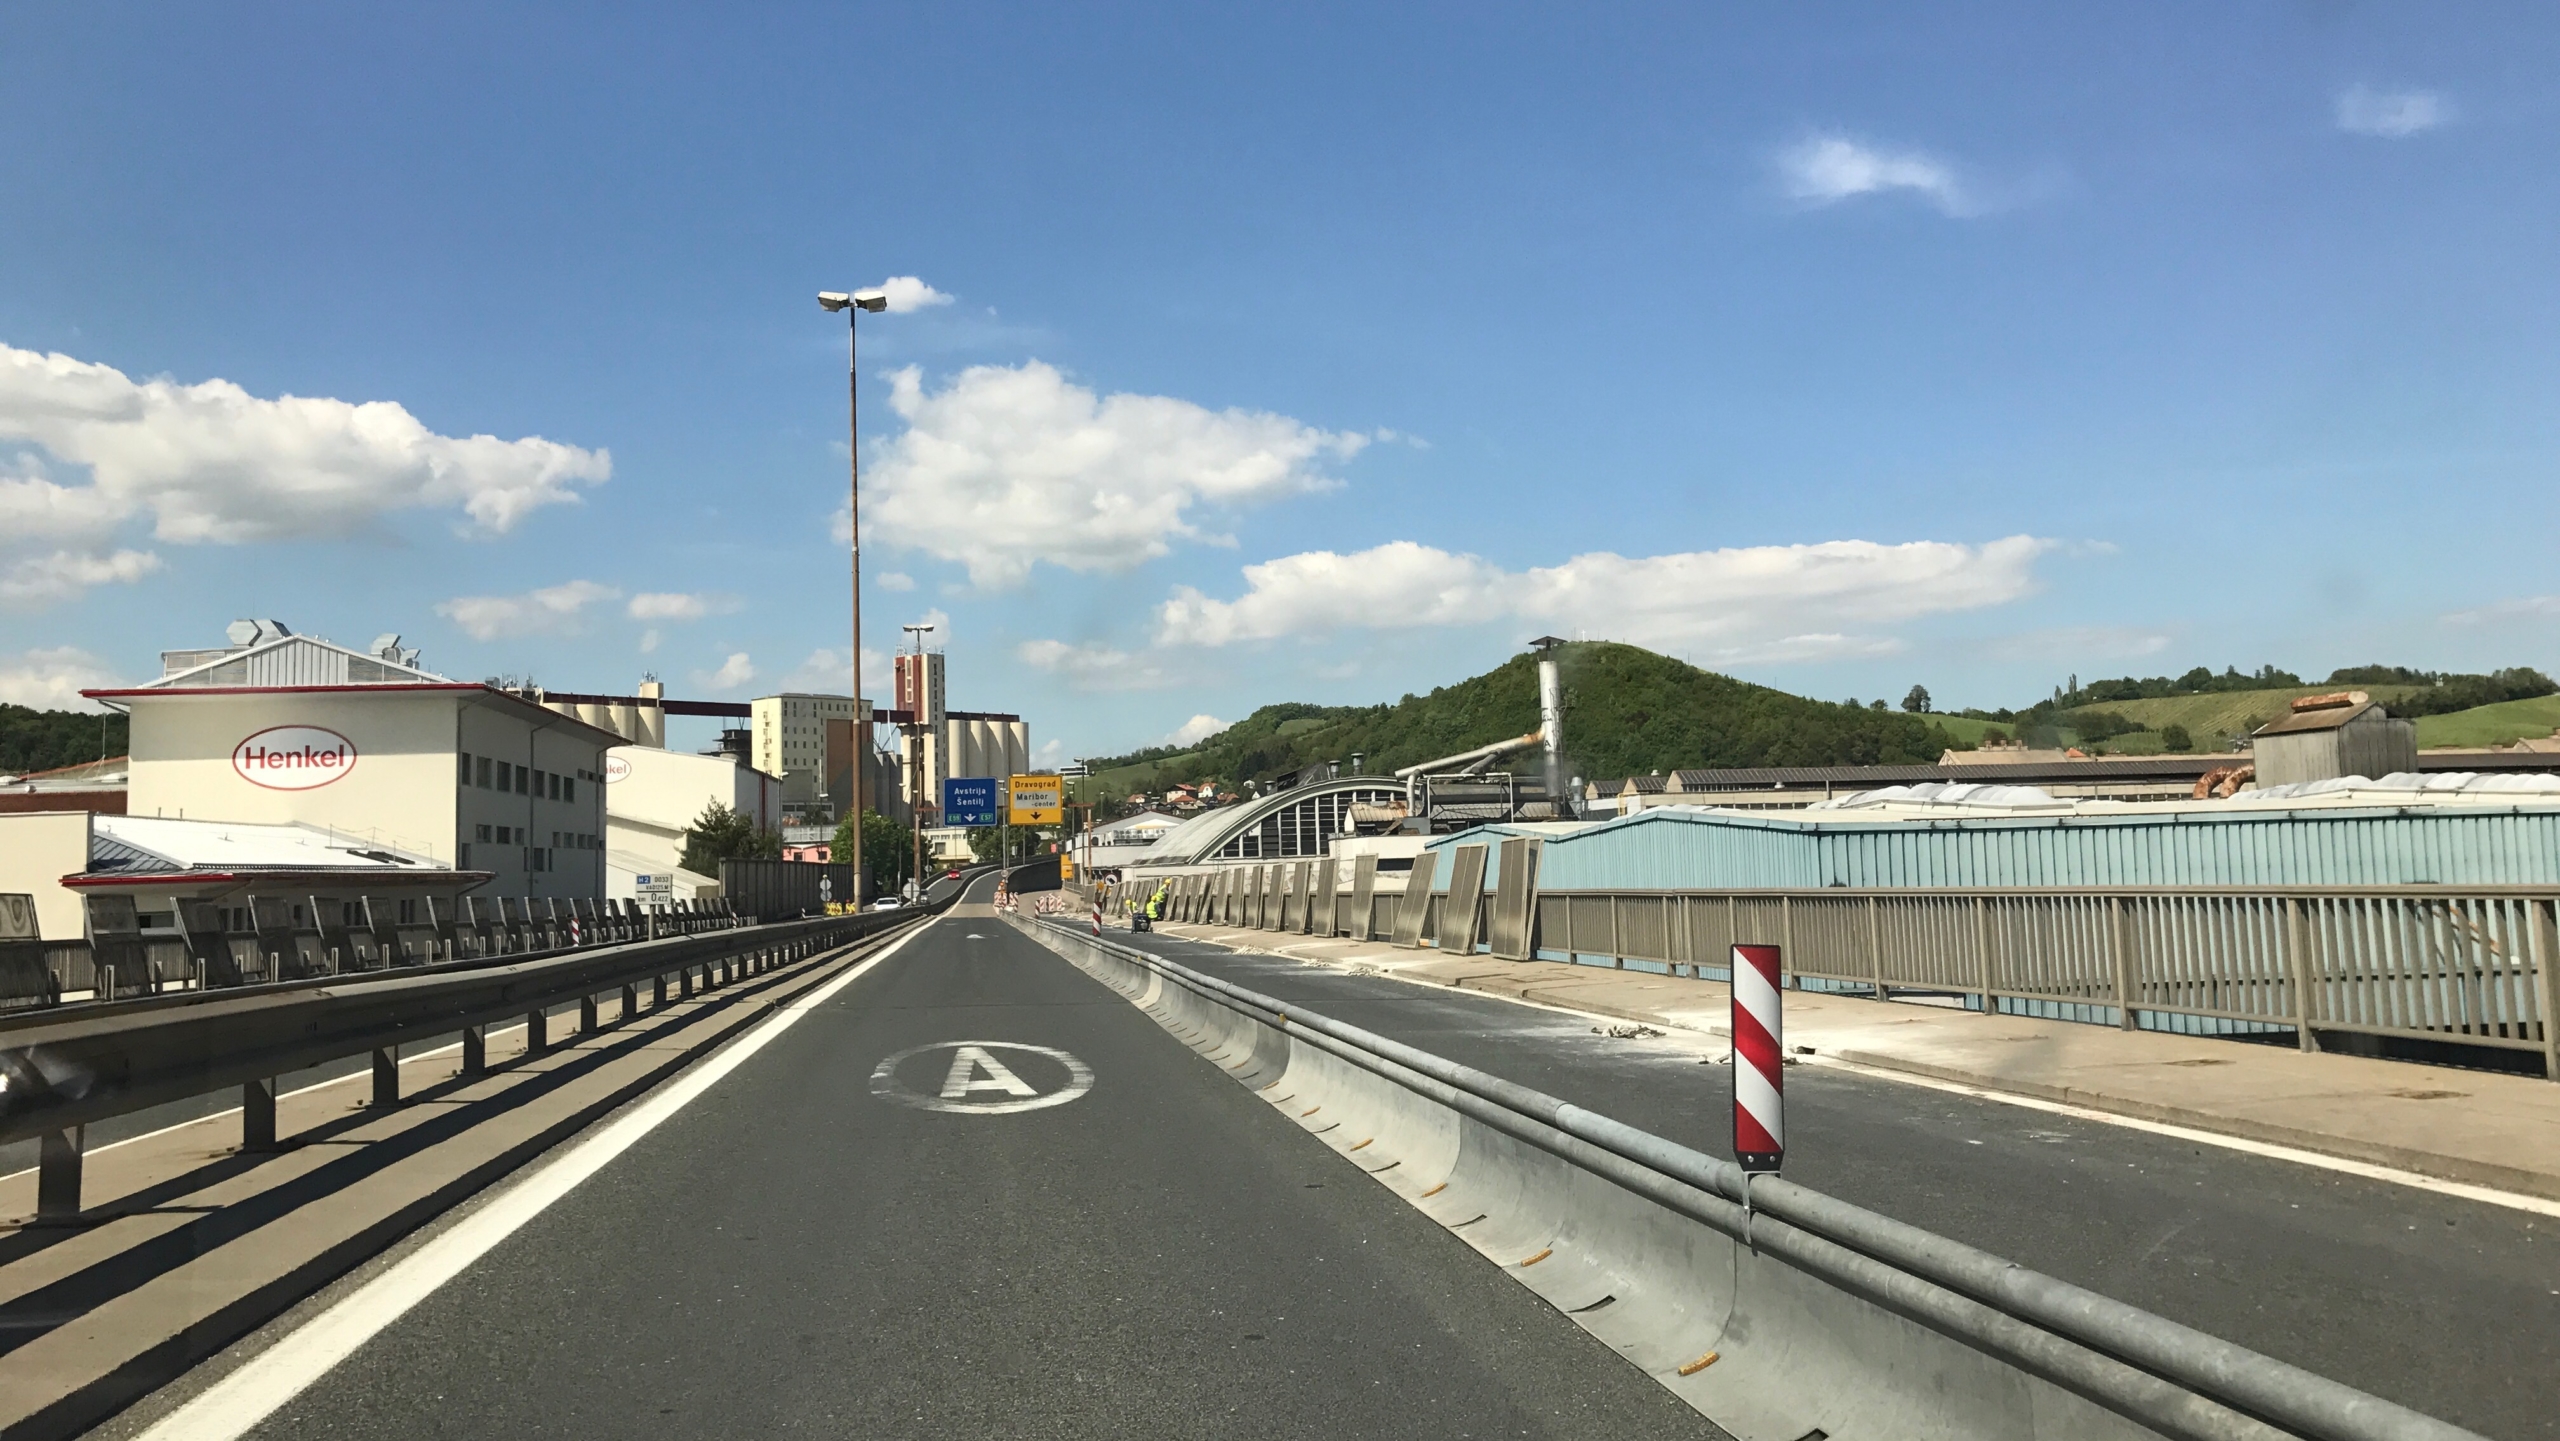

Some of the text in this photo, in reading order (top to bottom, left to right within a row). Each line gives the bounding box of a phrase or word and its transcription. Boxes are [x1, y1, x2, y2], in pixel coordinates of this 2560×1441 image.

[245, 744, 344, 769] Henkel
[1015, 780, 1056, 788] Dravograd
[954, 787, 986, 796] Avstrija
[956, 798, 984, 807] Šentilj
[939, 1046, 1039, 1098] A
